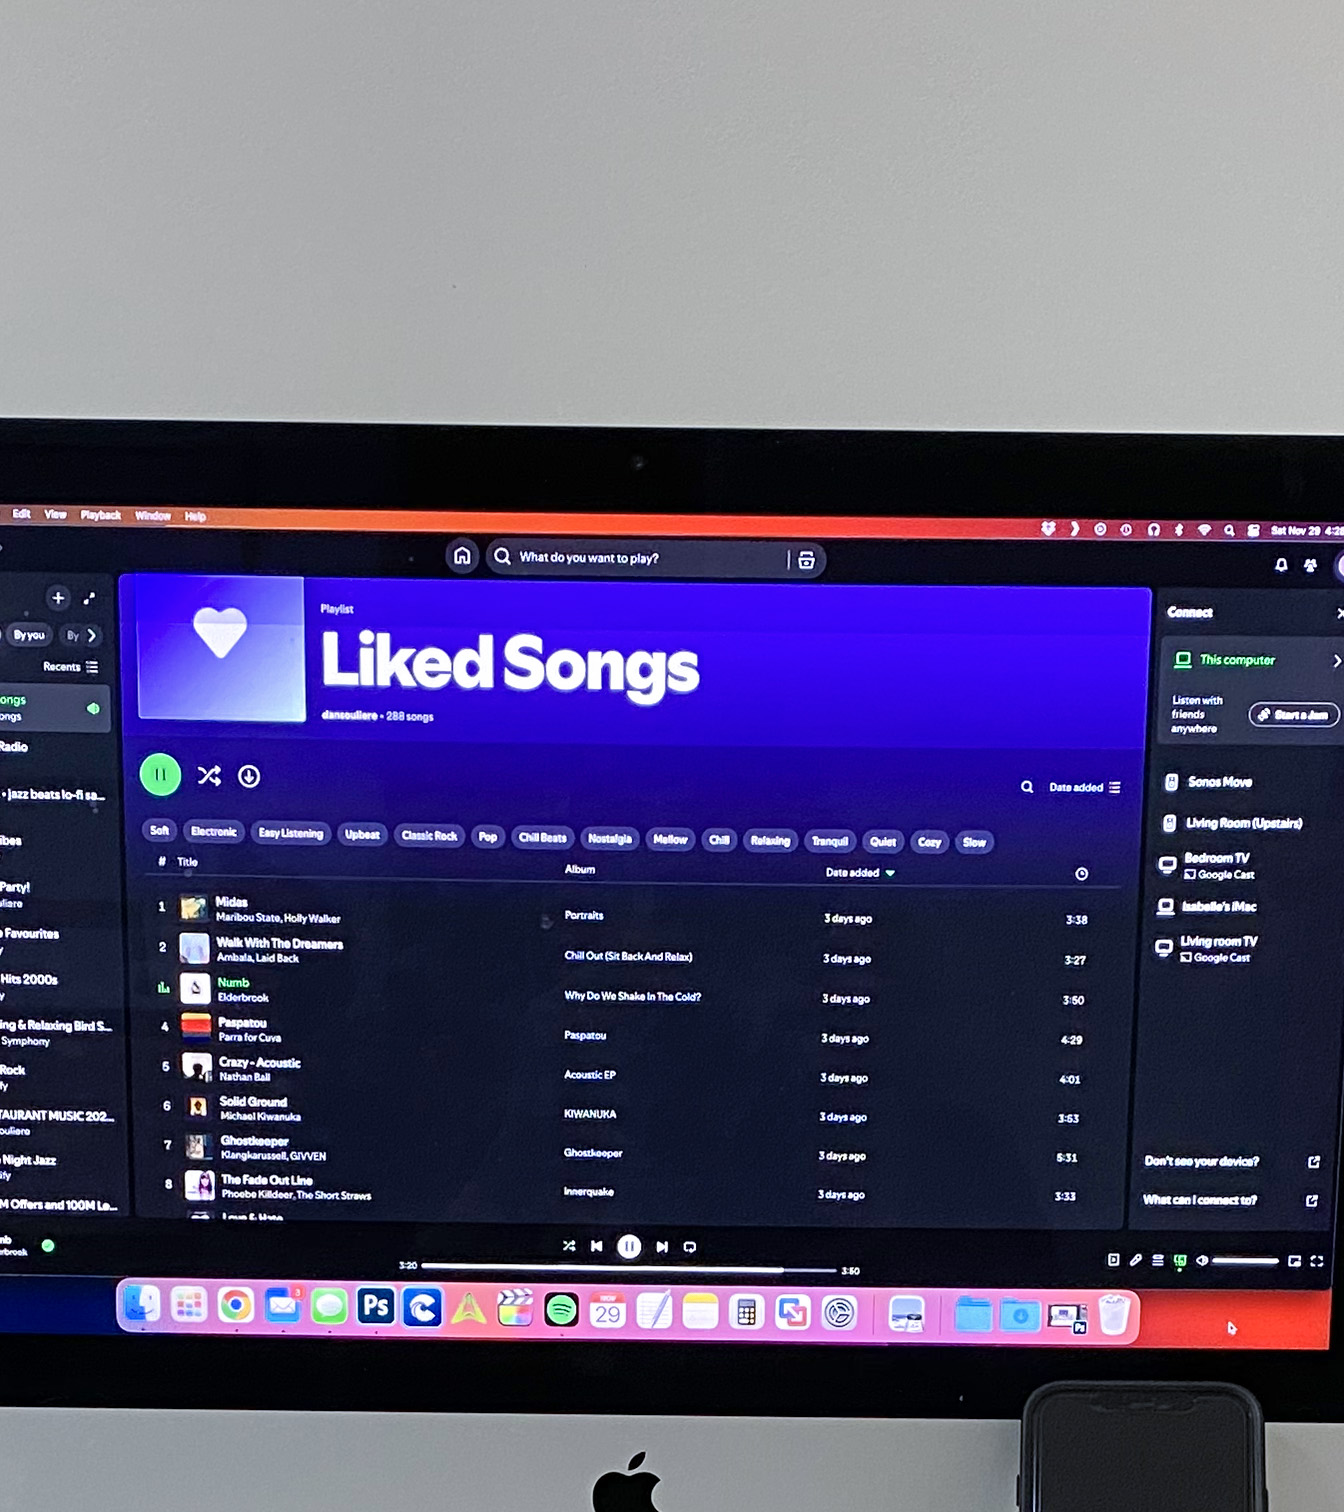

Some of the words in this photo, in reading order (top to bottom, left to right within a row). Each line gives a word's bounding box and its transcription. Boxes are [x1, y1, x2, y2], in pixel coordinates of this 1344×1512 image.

[12, 508, 31, 519] Edit
[45, 509, 67, 519] View
[80, 510, 122, 522] Playback
[135, 511, 172, 521] Window
[185, 511, 207, 523] Help
[1271, 526, 1286, 535] Sat
[1288, 526, 1306, 535] Nov
[1308, 526, 1321, 535] 29
[520, 551, 548, 562] What
[551, 552, 565, 562] do
[567, 555, 586, 564] you
[588, 554, 615, 563] want
[617, 555, 628, 563] to
[630, 553, 659, 565] play?
[321, 604, 354, 615] Playlist
[1167, 606, 1213, 618] Connect
[14, 630, 26, 641] By
[27, 632, 45, 641] you
[1200, 654, 1222, 665] This
[1223, 656, 1276, 667] computer
[44, 661, 81, 672] Recents
[323, 630, 494, 689] Liked
[504, 634, 700, 706] Songs
[406, 714, 434, 723] songs
[1189, 776, 1221, 787] Sonos
[1223, 776, 1252, 787] Move
[8, 789, 28, 801] jazz
[30, 788, 60, 800] beats
[1186, 817, 1218, 830] Living
[1220, 817, 1250, 828] Room
[150, 826, 169, 835] Soft
[191, 826, 237, 837] Electronic
[259, 827, 279, 839] Easy
[279, 828, 323, 840] Listening
[345, 829, 380, 841] Upbeat
[402, 830, 433, 840] Classic
[435, 831, 457, 841] Rock
[479, 832, 497, 843] Pop
[519, 832, 539, 842] Chill
[541, 833, 567, 843] Beats
[589, 833, 632, 845] Nostalgia
[654, 834, 688, 844] Mellow
[709, 835, 730, 845] Chill
[751, 836, 791, 847] Relaxing
[812, 836, 848, 847] Tranquil
[870, 837, 896, 847] Quiet
[918, 837, 942, 848] Cozy
[963, 837, 986, 847] Slow
[1185, 852, 1233, 863] Bedroom
[1235, 853, 1250, 863] TV
[565, 864, 595, 874] Album
[1198, 870, 1232, 881] Google
[1234, 870, 1255, 879] Cast
[0, 881, 30, 894] Party!
[216, 896, 248, 907] Midas
[216, 912, 254, 921] Maribou
[284, 913, 307, 924] Holly
[308, 914, 341, 923] Walker
[565, 910, 604, 920] Portraits
[832, 914, 853, 924] days
[855, 916, 872, 925] ago
[1066, 915, 1087, 925] 3:38
[5, 928, 59, 939] Favourites
[216, 937, 243, 947] Walk
[244, 937, 270, 948] With
[271, 938, 290, 948] The
[293, 938, 343, 950] Dreamers
[256, 953, 275, 962] Laid
[277, 954, 299, 963] Back
[1, 974, 21, 984] Hits
[23, 974, 58, 985] 2000s
[218, 977, 250, 987] Numb
[218, 992, 269, 1002] Elderbrook
[28, 1020, 72, 1033] Relaxing
[74, 1021, 95, 1031] Bird
[218, 1017, 267, 1029] Paspatou
[1, 1036, 50, 1047] Symphony
[244, 1033, 257, 1042] for
[259, 1033, 281, 1042] Cuva
[219, 1056, 248, 1069] Crazy
[256, 1057, 301, 1068] Acoustic
[0, 1064, 25, 1075] Rock
[564, 1070, 602, 1079] Acoustic
[604, 1070, 616, 1079] EP
[220, 1072, 252, 1081] Nathan
[220, 1096, 246, 1107] Solid
[248, 1096, 287, 1107] Ground
[49, 1110, 84, 1121] MUSIC
[564, 1109, 616, 1118] KIWANUKA
[3, 1154, 31, 1167] Night
[33, 1155, 56, 1165] Jazz
[364, 1294, 388, 1316] Ps
[596, 1306, 620, 1323] 29
